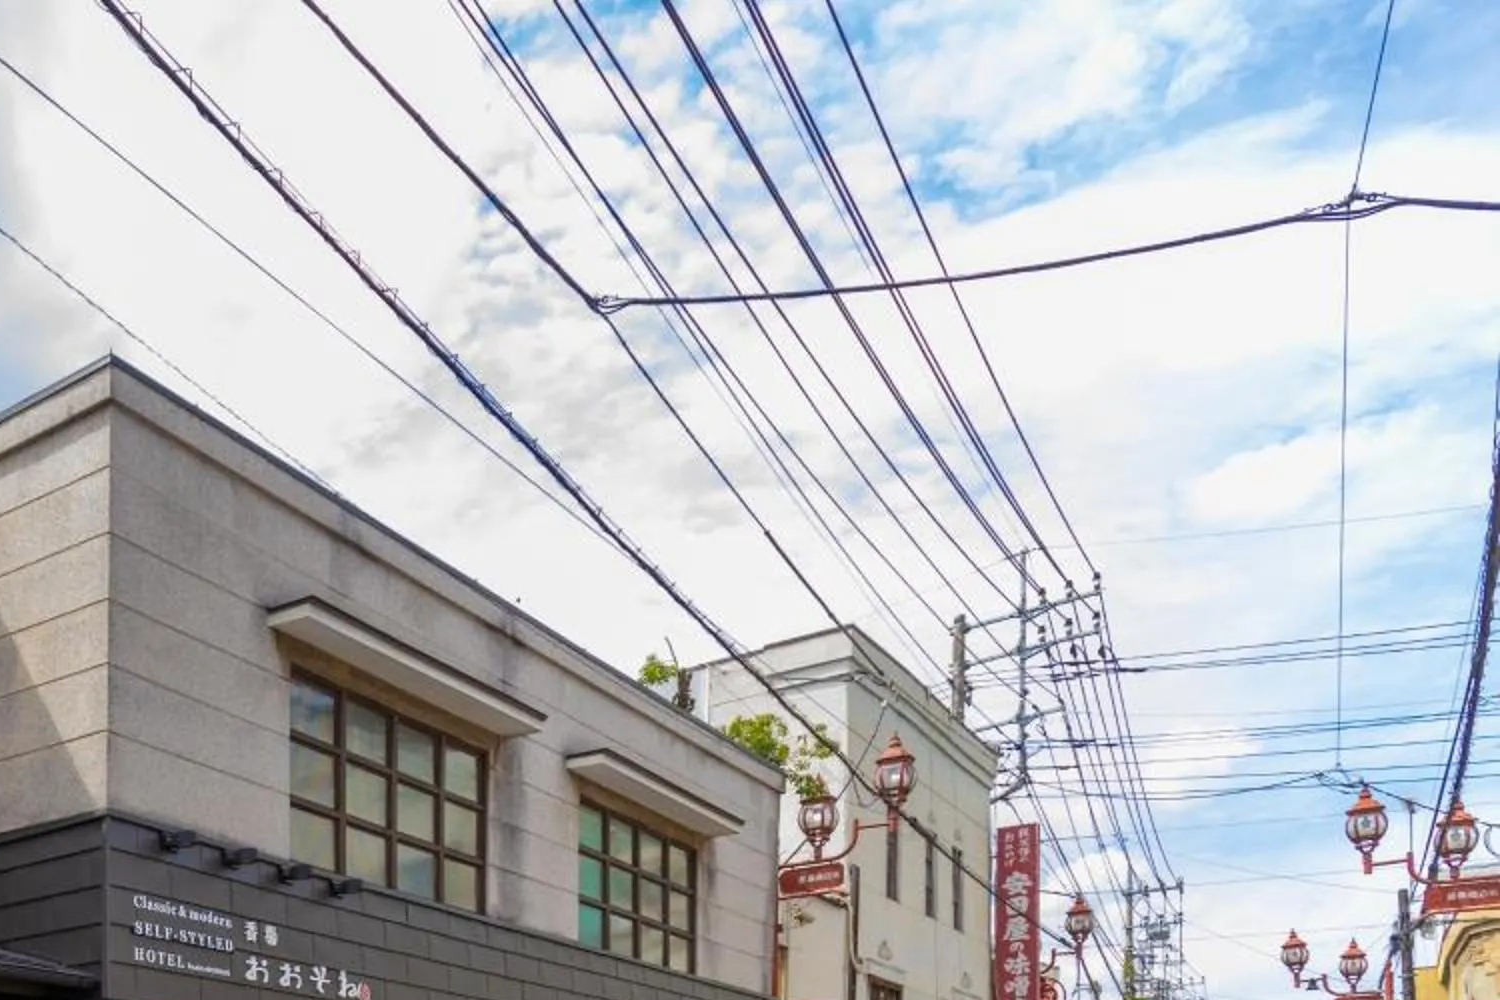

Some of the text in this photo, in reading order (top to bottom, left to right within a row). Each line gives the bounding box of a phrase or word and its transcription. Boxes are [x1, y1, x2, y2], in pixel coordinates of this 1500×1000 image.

[133, 946, 186, 969] HOTEL
[244, 955, 362, 999] おおそね
